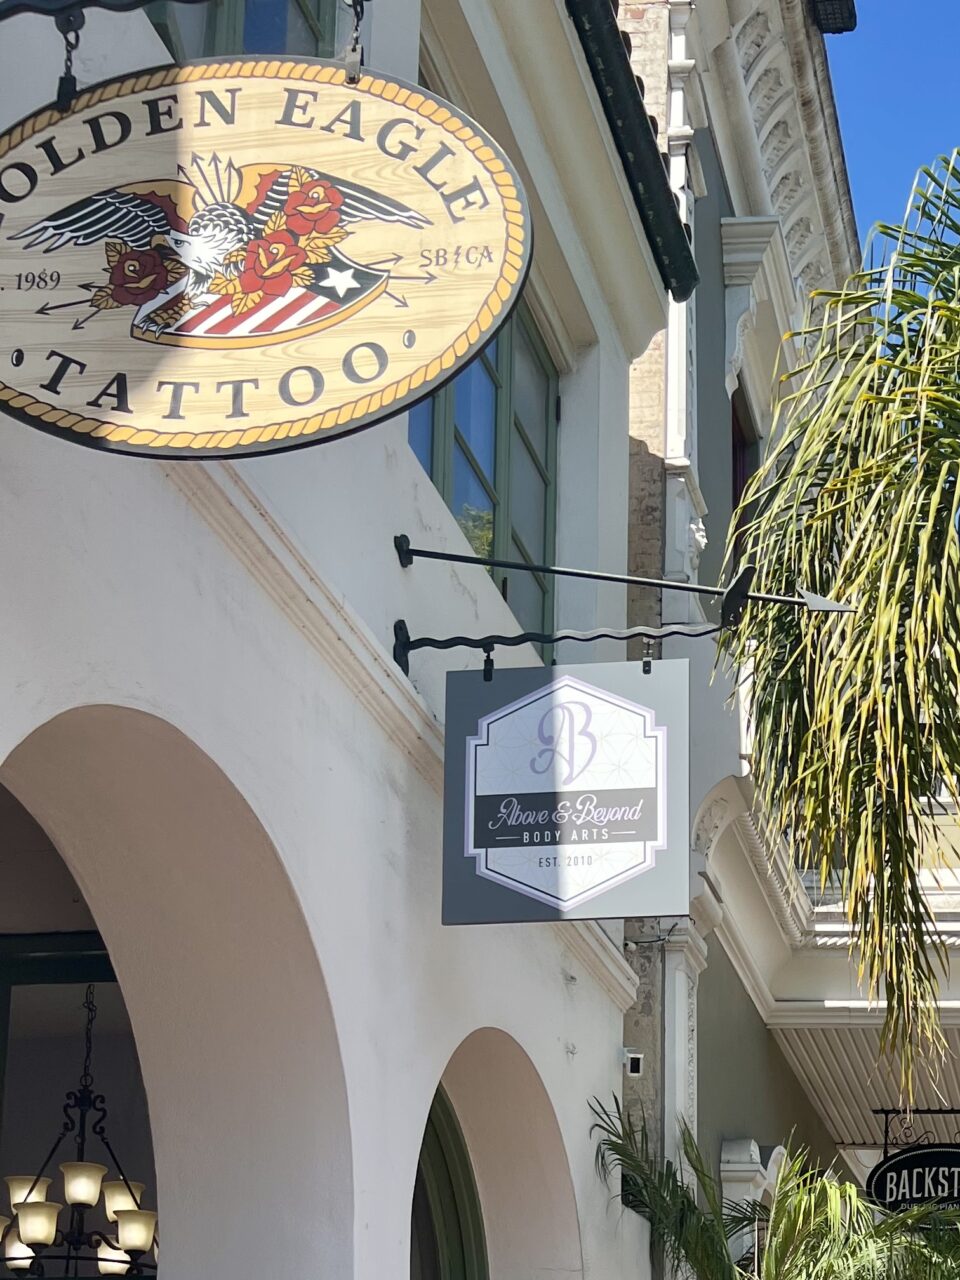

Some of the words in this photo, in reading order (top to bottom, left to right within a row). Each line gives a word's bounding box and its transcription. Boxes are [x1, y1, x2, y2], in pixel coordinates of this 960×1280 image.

[0, 87, 243, 231] OLDEN
[274, 87, 489, 224] EAGLE
[15, 268, 61, 291] 1989
[38, 341, 390, 421] TATTOO
[488, 797, 549, 830] Above
[551, 801, 573, 823] &
[572, 794, 644, 826] Beyond
[523, 831, 561, 843] BODY
[571, 828, 609, 841] ARTS
[538, 857, 561, 868] EST.
[567, 855, 592, 867] 2010
